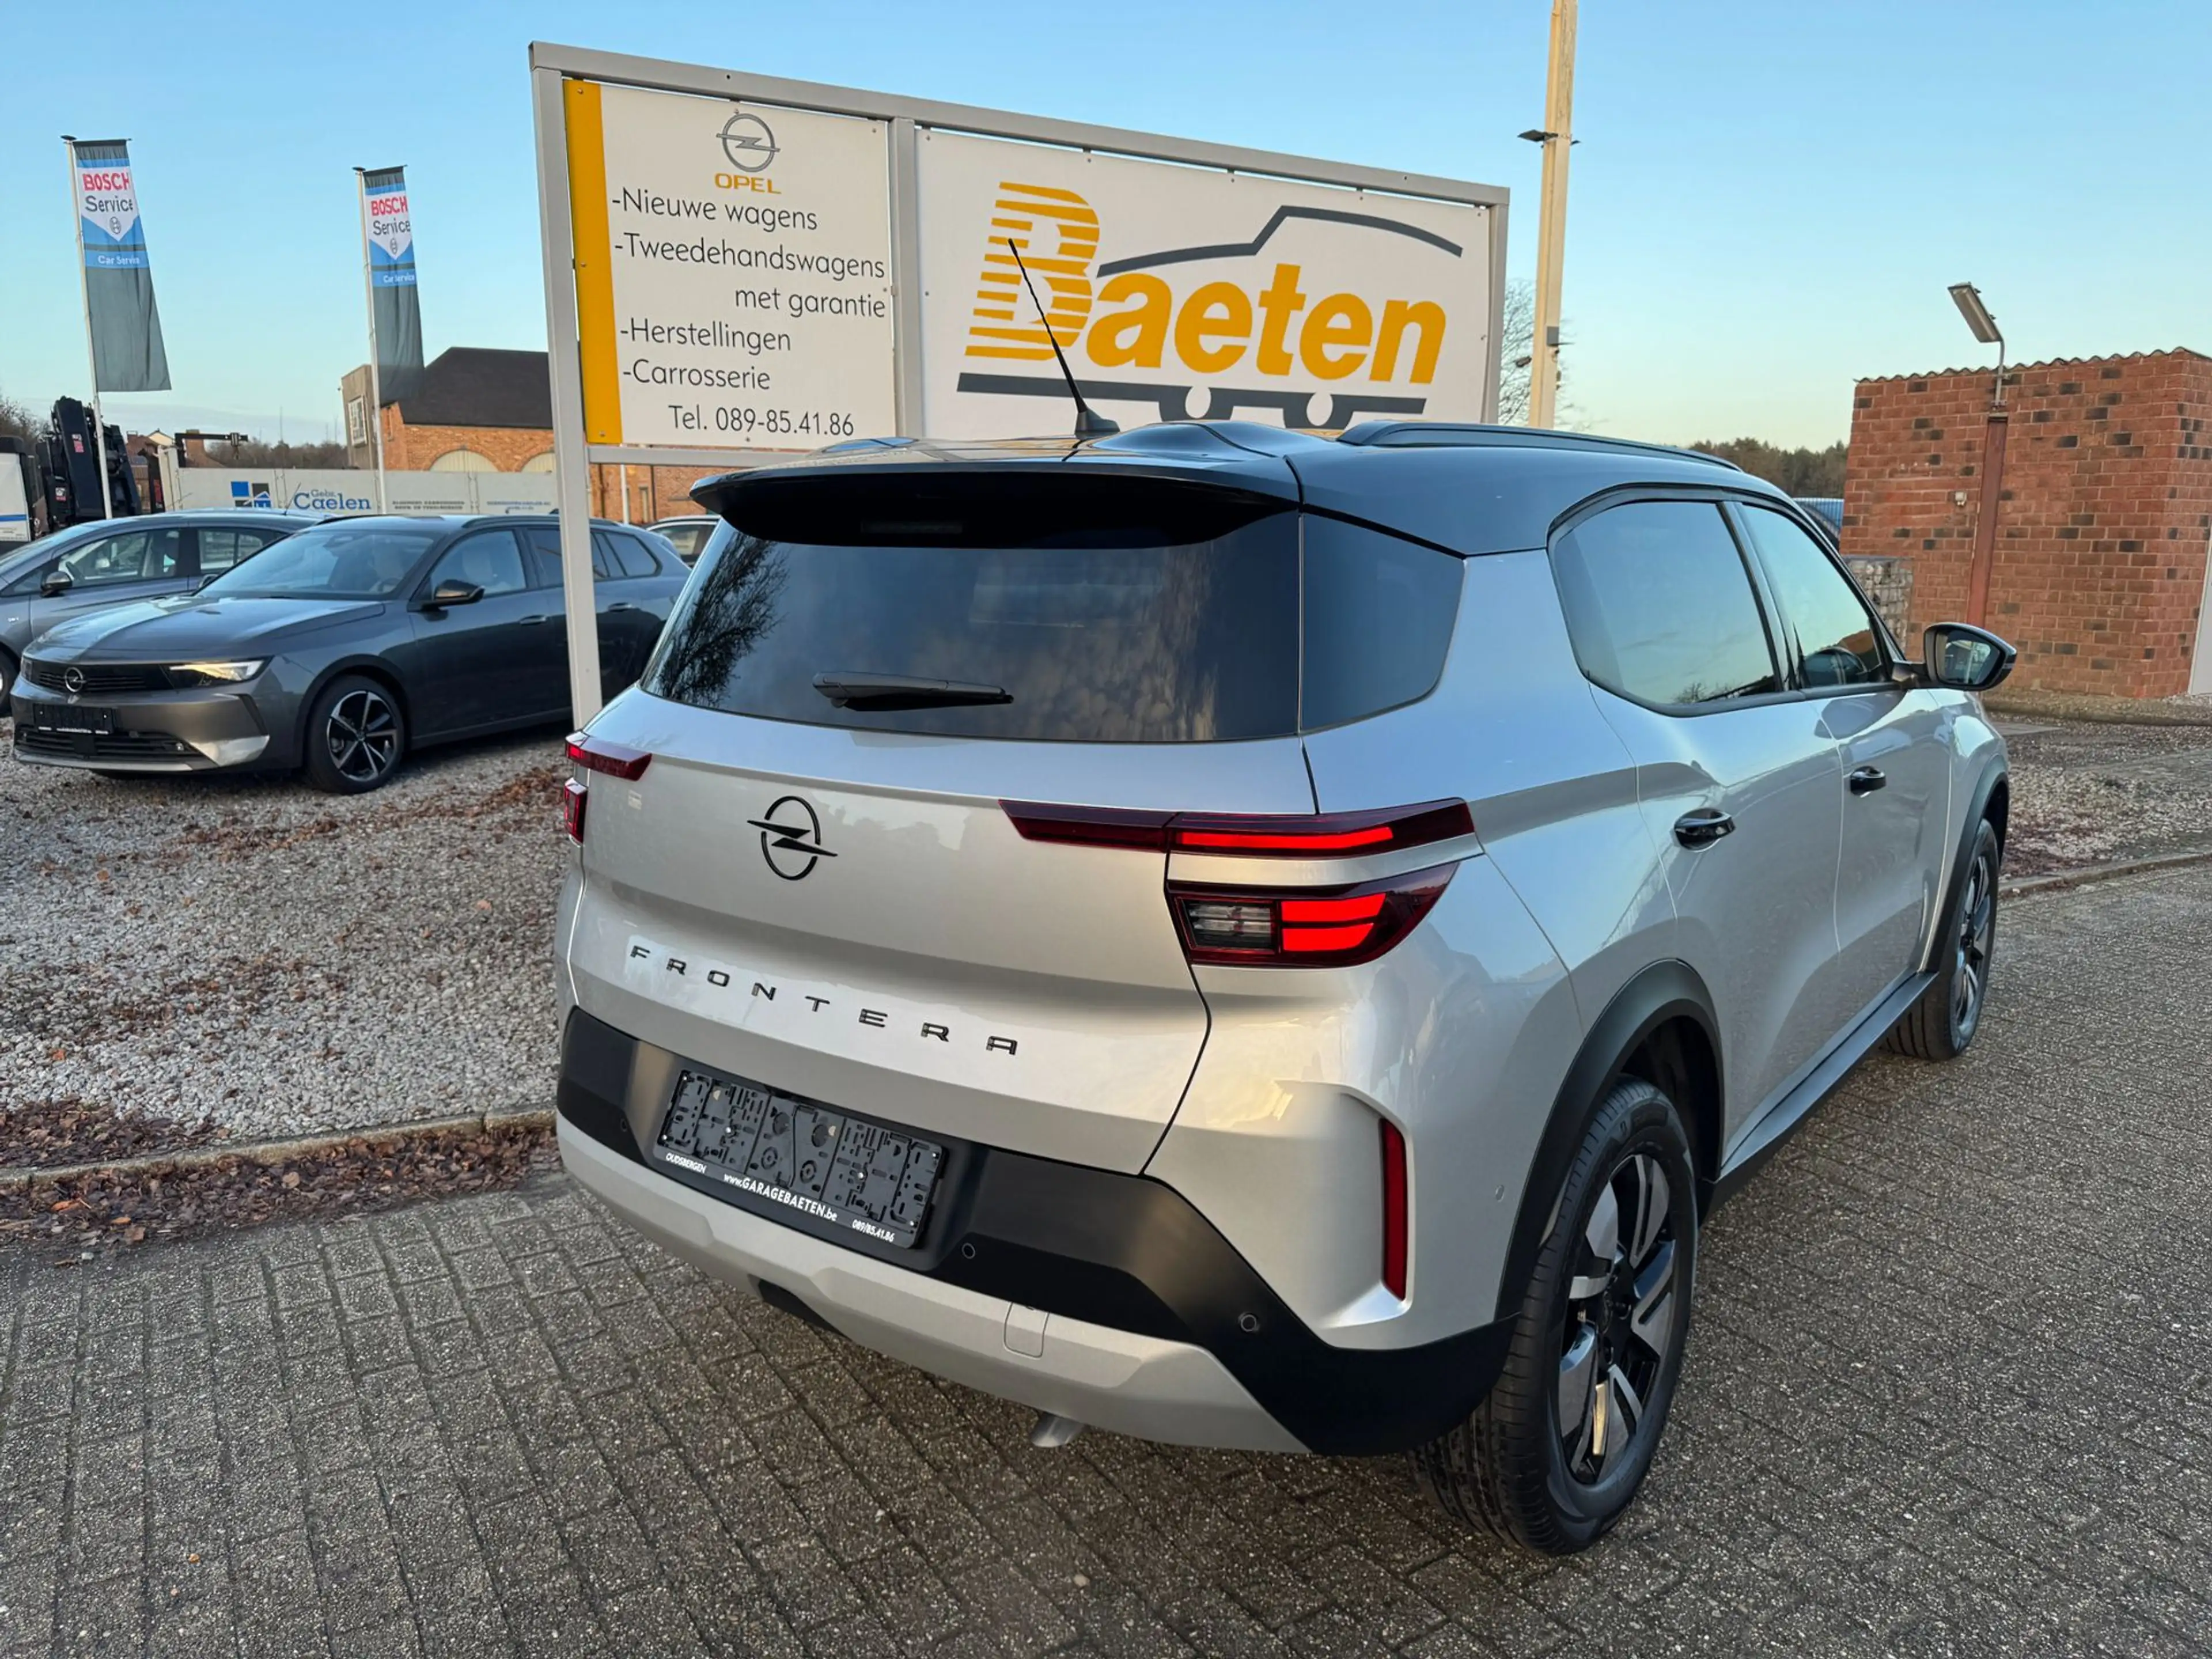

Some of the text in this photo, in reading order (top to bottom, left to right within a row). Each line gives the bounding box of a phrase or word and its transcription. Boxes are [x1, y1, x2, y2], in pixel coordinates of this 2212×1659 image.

[82, 172, 131, 191] BOSCH
[714, 173, 782, 194] OPEL
[85, 195, 134, 213] Service
[371, 196, 408, 216] BOSCH
[612, 188, 817, 232] -Nieuwe wagens
[98, 255, 114, 265] Car
[615, 232, 885, 281] -Tweedehandswagens
[965, 181, 1446, 385] Baeten
[735, 288, 886, 317] met garantie
[620, 318, 791, 355] -Herstellingen
[623, 359, 771, 390] -Carrosserie
[668, 404, 854, 437] Tel. 089-85.41.86
[294, 493, 372, 510] Caelen
[630, 945, 1018, 1055] FRONTERA
[665, 1152, 707, 1175] OUDSBERGEN
[724, 1174, 838, 1221] www.GARAGEBAETEN.be
[852, 1219, 895, 1243] 089/85.41.86
